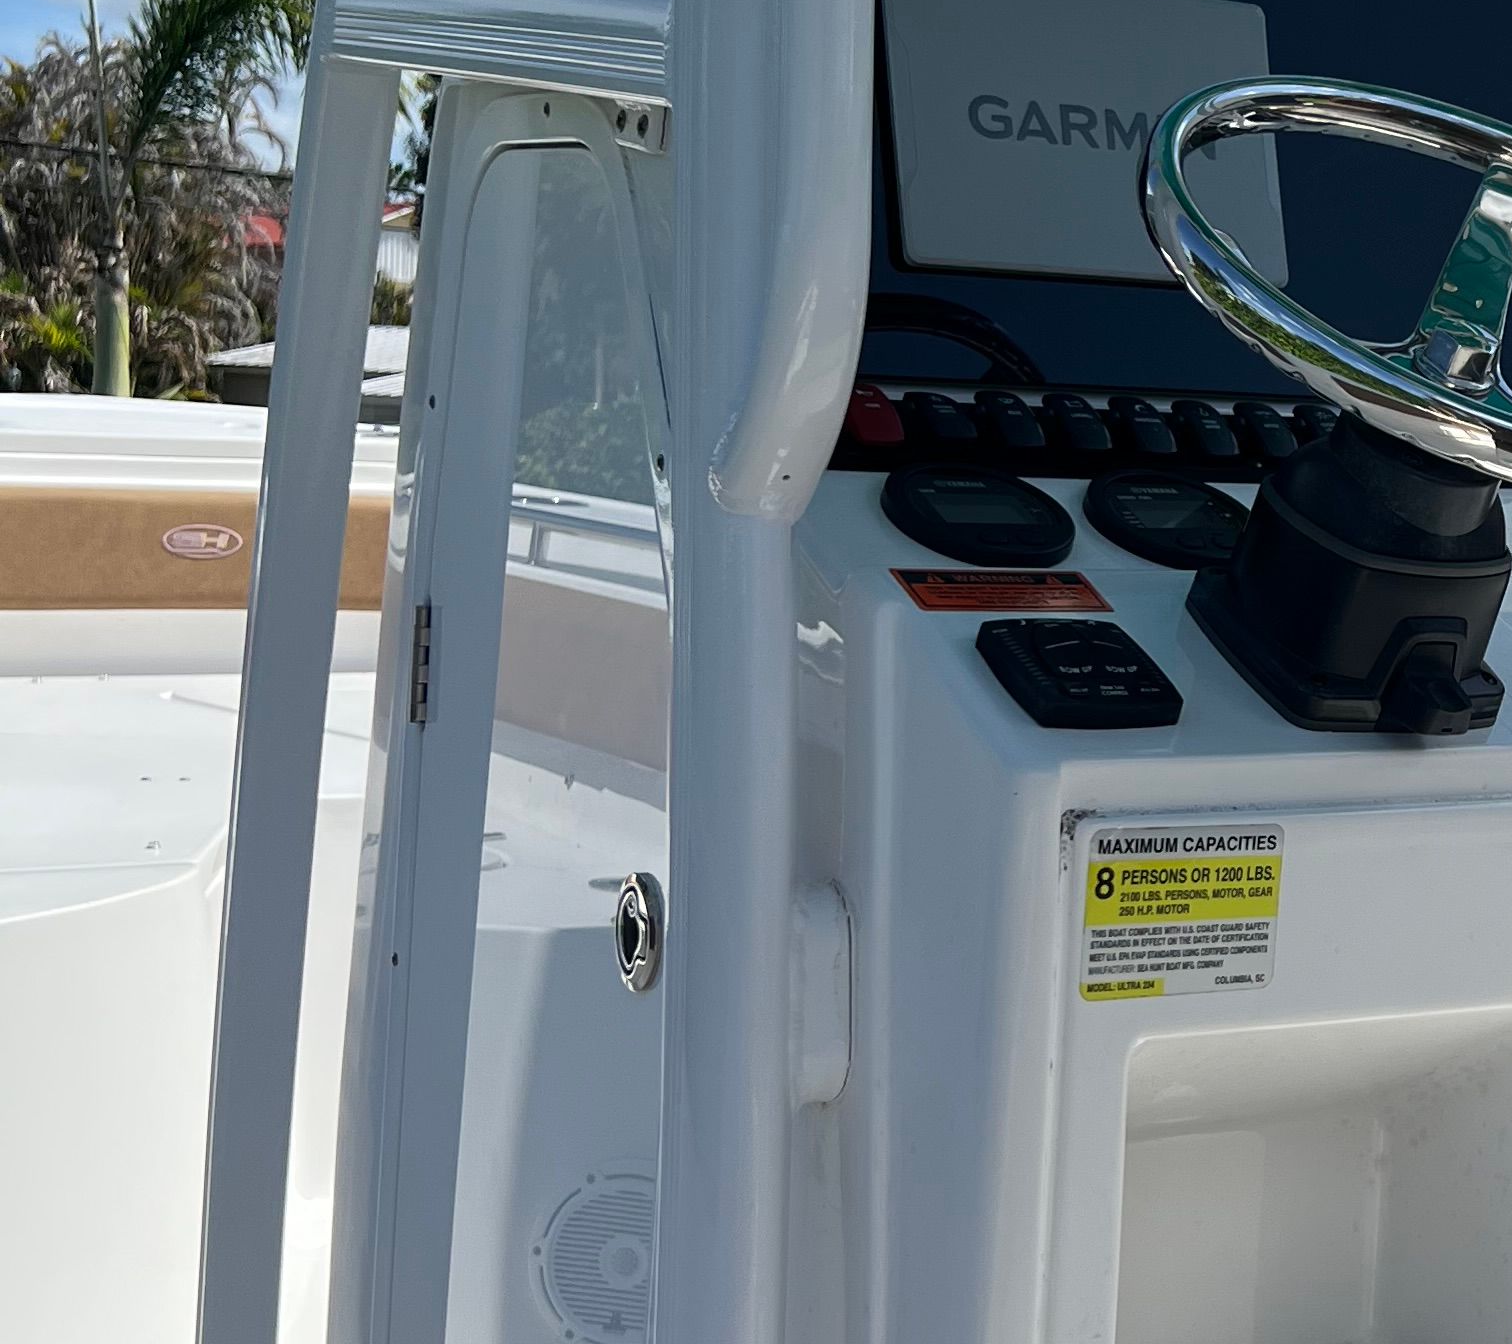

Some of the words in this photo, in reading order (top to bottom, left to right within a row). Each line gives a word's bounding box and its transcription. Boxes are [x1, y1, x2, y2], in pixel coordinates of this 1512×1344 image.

[967, 94, 1216, 161] GARM
[1098, 837, 1178, 854] MAXIMUM
[1183, 835, 1277, 852] CAPACITIES
[1095, 866, 1115, 900] 8
[1122, 869, 1187, 885] PERSONS
[1191, 868, 1210, 882] OR
[1215, 867, 1243, 882] 1200
[1246, 866, 1275, 881] LBS.
[1142, 891, 1163, 901] LBS.
[1165, 889, 1209, 901] PERSONS,
[1212, 888, 1246, 899] MOTOR,
[1248, 887, 1273, 897] GEAR
[1119, 906, 1135, 916] 250
[1137, 905, 1154, 915] H.P.
[1156, 904, 1190, 915] MOTOR
[1109, 928, 1127, 938] BOAT
[1196, 924, 1219, 933] COAST
[1245, 922, 1270, 931] SAFETY
[1141, 937, 1166, 946] EFFECT
[1179, 936, 1192, 944] THE
[1193, 935, 1209, 944] DATE
[1222, 933, 1269, 943] CERTIFICATION
[1117, 981, 1141, 991] ULTRA
